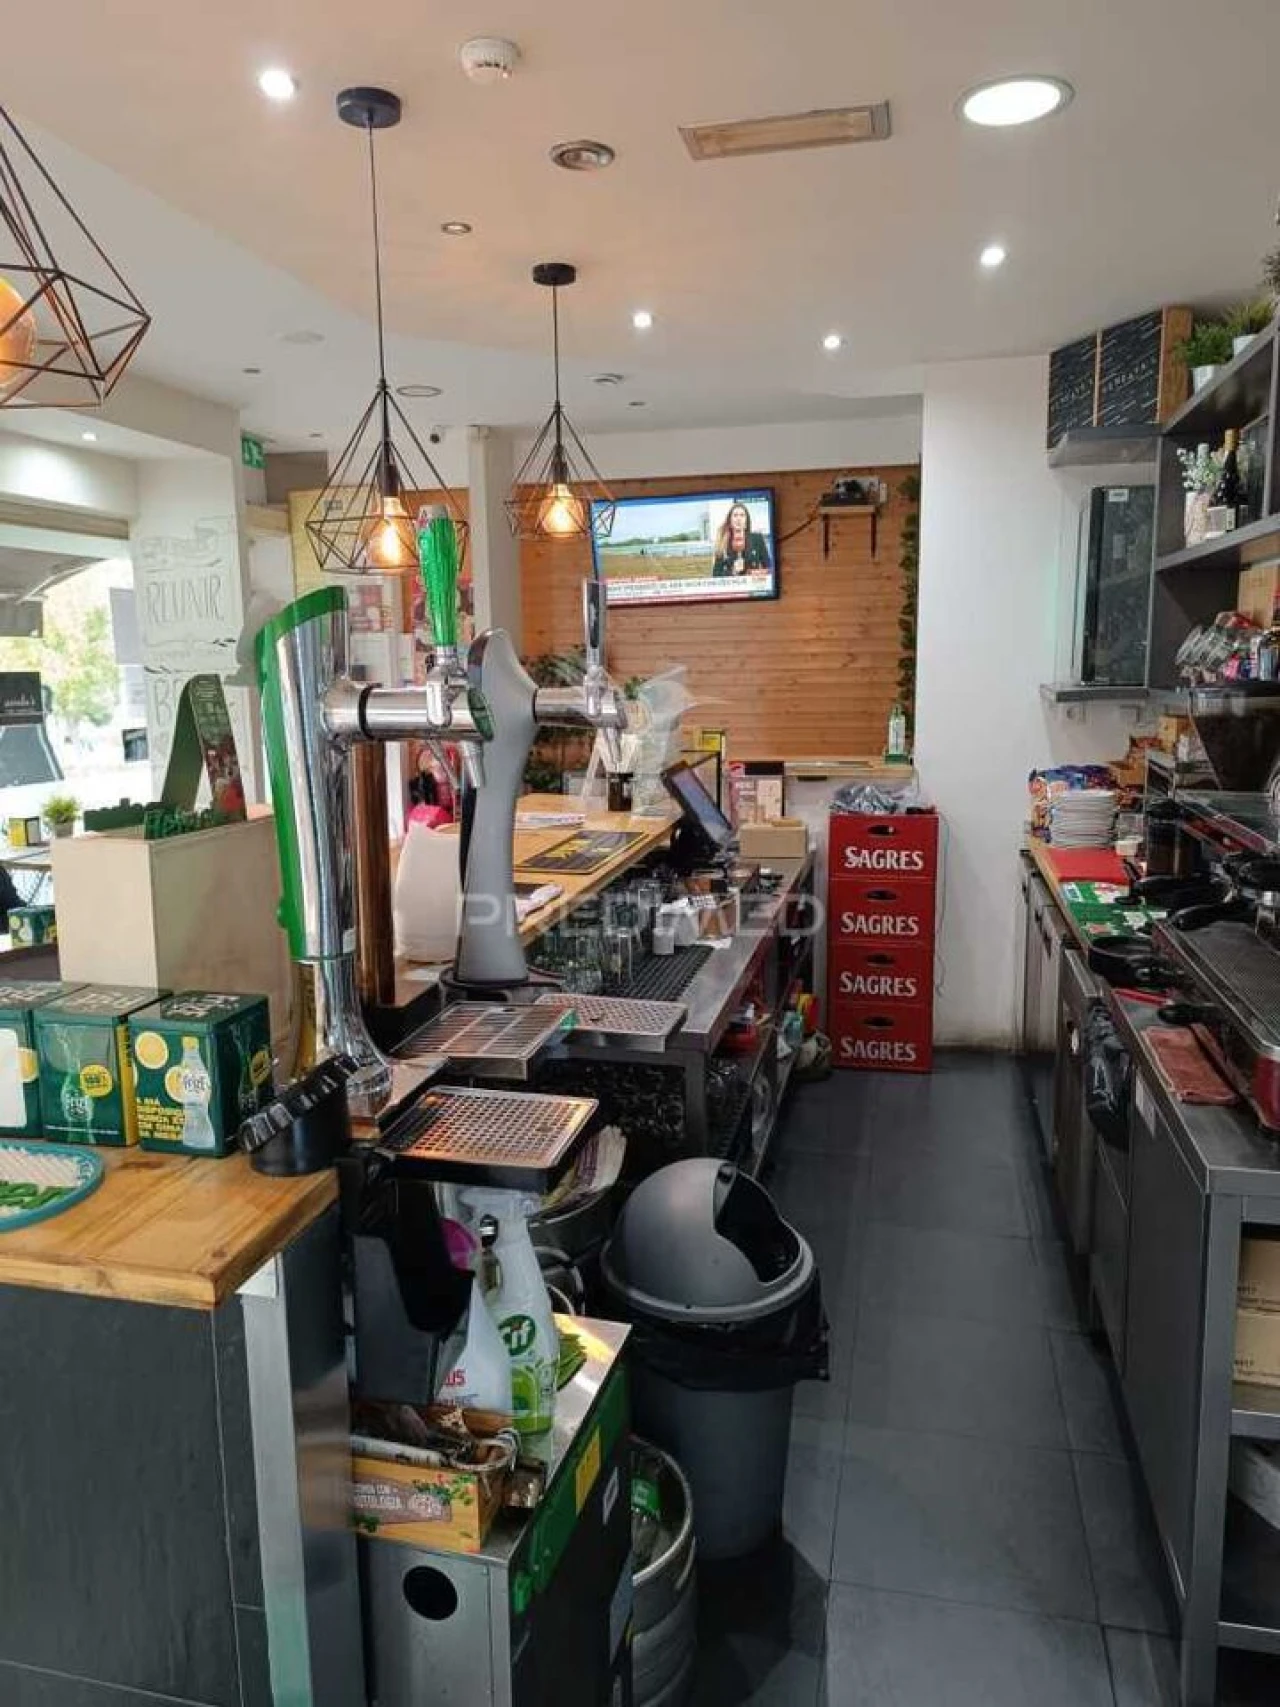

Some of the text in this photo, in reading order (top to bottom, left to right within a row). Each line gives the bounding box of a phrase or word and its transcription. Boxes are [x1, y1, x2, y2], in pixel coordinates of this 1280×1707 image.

[844, 846, 925, 870] SAGRES
[840, 911, 920, 936] SAGRES
[839, 971, 918, 997] SAGRES
[840, 1036, 917, 1062] SAGRES
